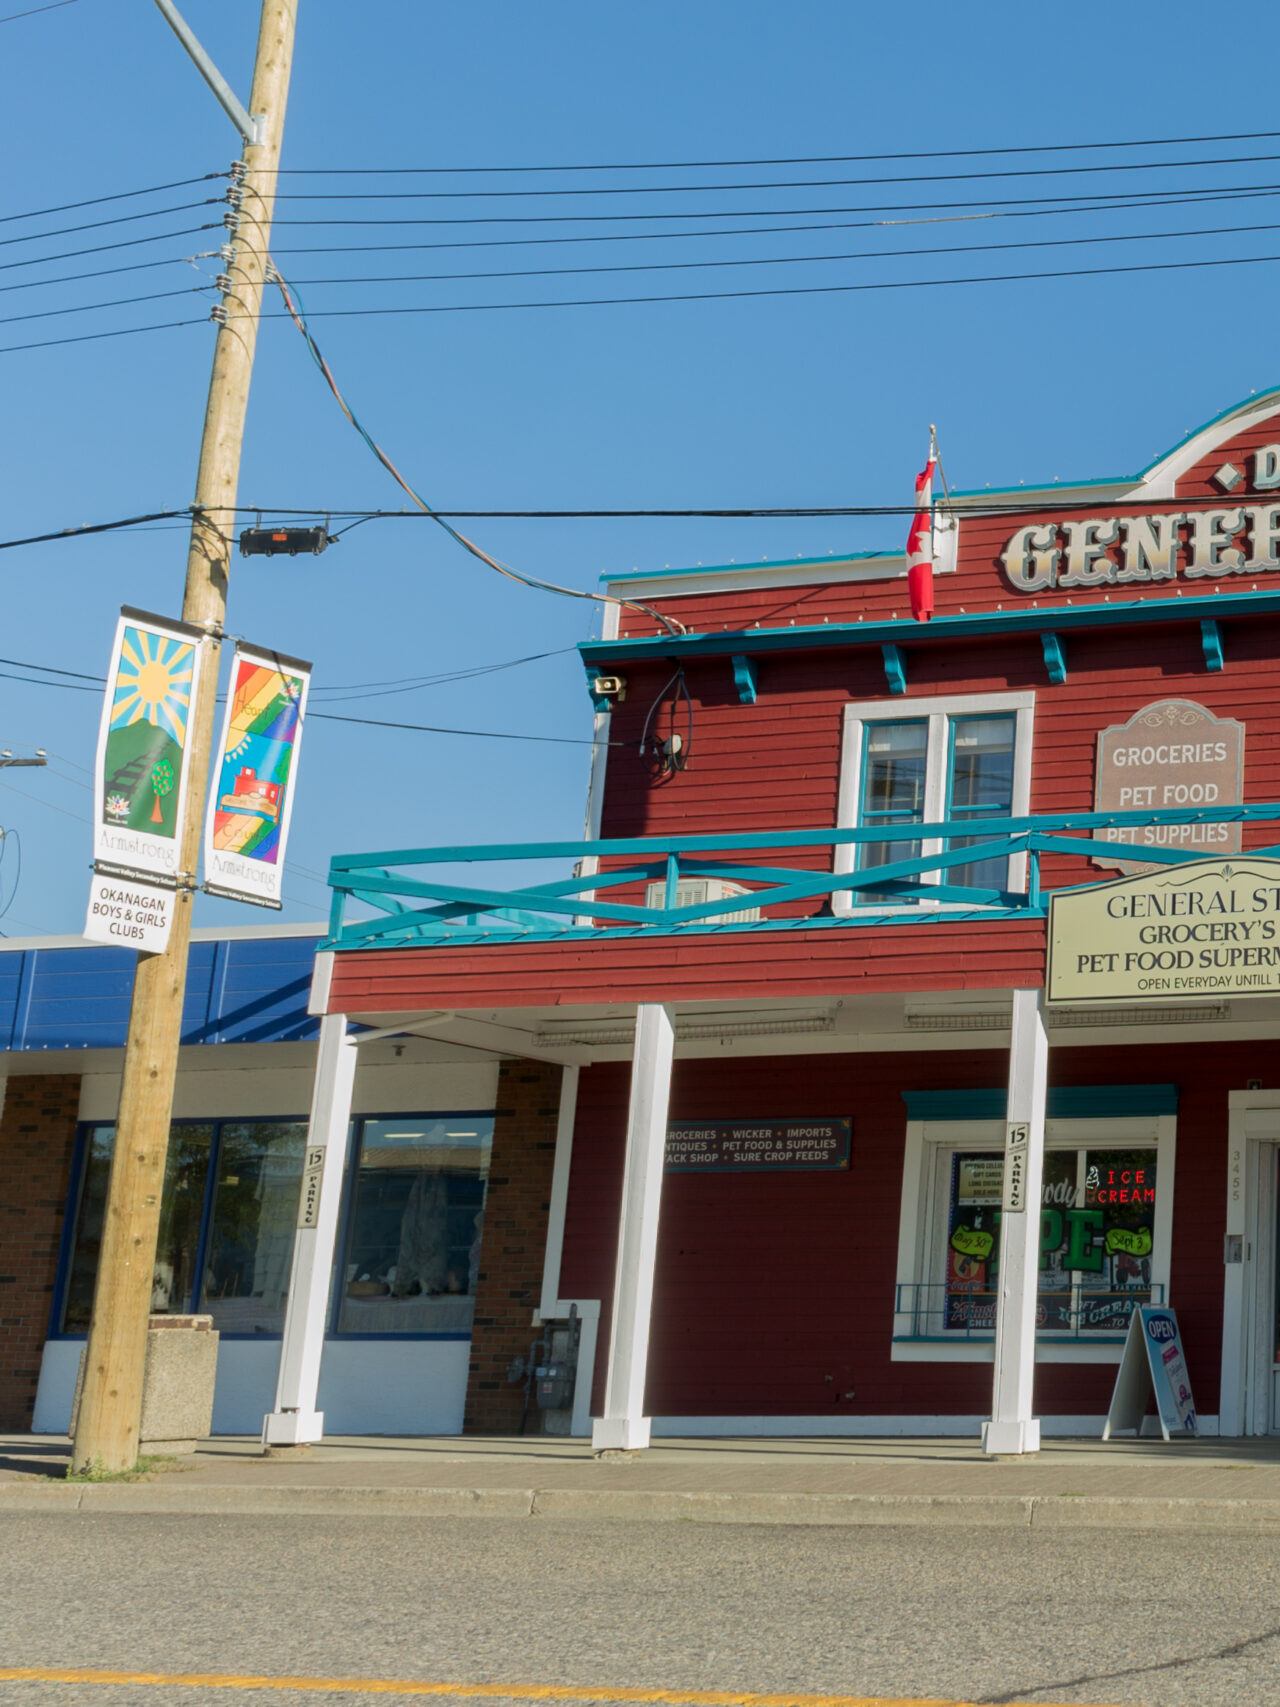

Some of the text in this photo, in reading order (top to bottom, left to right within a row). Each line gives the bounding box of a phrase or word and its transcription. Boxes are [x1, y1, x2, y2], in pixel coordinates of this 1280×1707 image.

[1113, 742, 1227, 767] GROCERIES
[1119, 783, 1218, 807] PET FOOD
[1107, 822, 1229, 845] PET SUPPLIES
[100, 830, 175, 868] Armstrong
[212, 855, 276, 892] Armstrong
[100, 888, 165, 911] OKANAGAN
[1107, 890, 1245, 919] GENERAL
[93, 902, 166, 928] BOYS & GIRLS
[109, 922, 144, 940] CLUBS
[1139, 920, 1276, 946] GROCERY'S
[1077, 953, 1120, 974] PET
[1124, 950, 1194, 972] FOOD
[1137, 978, 1171, 991] OPEN
[1174, 975, 1232, 989] EVERYDAY
[1235, 973, 1272, 987] UNTILL
[732, 1129, 772, 1139] WICKER
[787, 1128, 832, 1138] IMPORTS
[1011, 1126, 1025, 1144] 15
[665, 1139, 837, 1151] NTIQUES PET FOOD & SUPPLIES
[309, 1149, 322, 1165] 15
[690, 1153, 719, 1163] SHOP
[733, 1152, 761, 1162] SURE
[764, 1152, 793, 1161] CROP
[795, 1151, 829, 1161] FEEDS
[1011, 1155, 1021, 1206] PARKING
[1107, 1170, 1145, 1184] ICE
[305, 1176, 317, 1223] PARKING
[1097, 1189, 1155, 1203] CREAM
[1114, 1233, 1143, 1249] Sept 3
[969, 1319, 996, 1328] CHEE
[1149, 1320, 1174, 1339] OPEN
